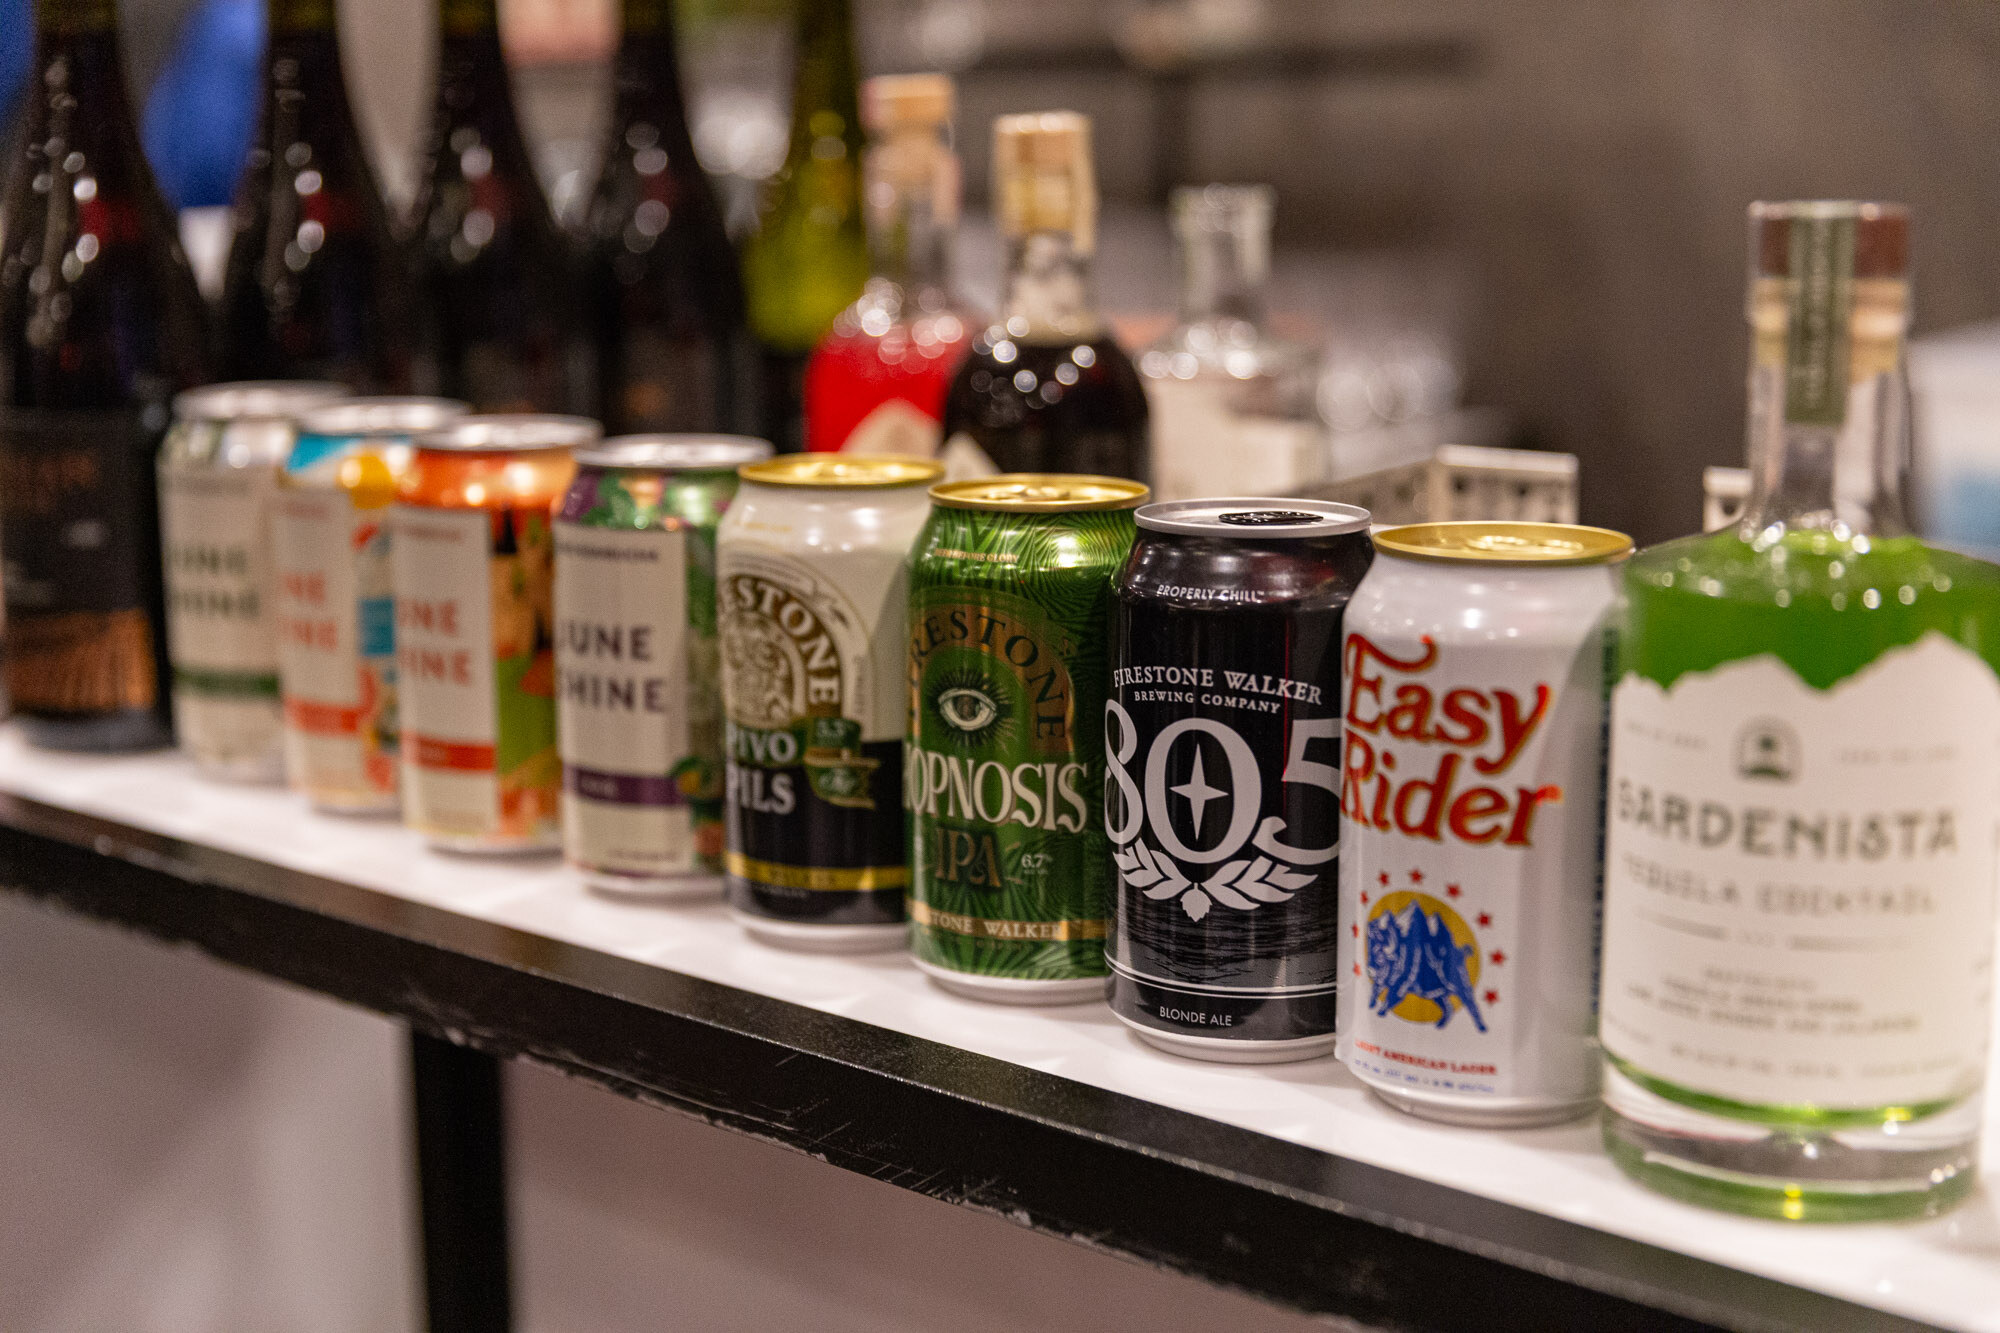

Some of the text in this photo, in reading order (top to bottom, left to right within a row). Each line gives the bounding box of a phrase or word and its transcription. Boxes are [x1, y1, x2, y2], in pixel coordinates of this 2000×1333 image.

[987, 552, 1017, 563] GLORY
[1156, 584, 1216, 600] PROPERLY
[1113, 666, 1323, 706] FIRESTONE WALKER
[1134, 690, 1281, 714] BREWING COMPANY
[1345, 632, 1552, 776] Easy
[1105, 698, 1340, 865] 805
[1341, 726, 1564, 848] Rider
[1619, 777, 1958, 861] GARDENISTA
[934, 827, 1003, 888] IPA
[1159, 1005, 1233, 1027] BLONDE ALE
[1382, 1049, 1449, 1071] AMERICAN
[1450, 1061, 1498, 1076] LAGER
